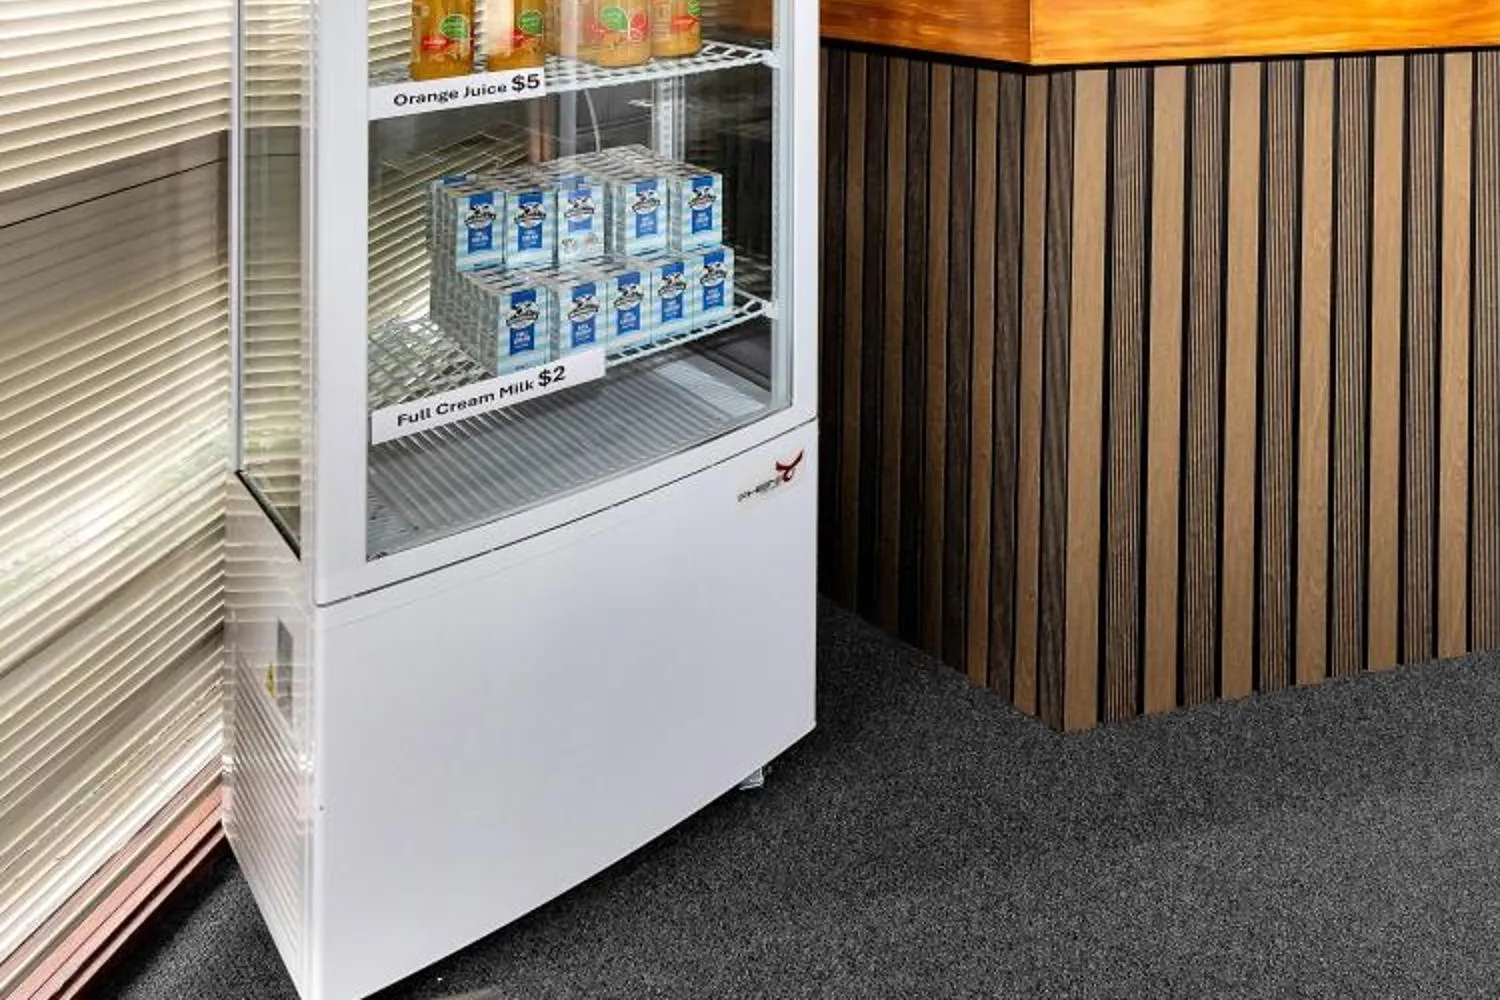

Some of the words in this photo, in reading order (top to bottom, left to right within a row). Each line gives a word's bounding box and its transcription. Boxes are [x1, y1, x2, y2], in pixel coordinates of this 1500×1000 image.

[393, 88, 459, 107] Orange
[463, 81, 508, 99] Juice
[511, 72, 541, 93] $5
[397, 409, 432, 427] Full
[436, 393, 496, 416] Cream
[500, 380, 534, 398] Milk
[538, 365, 567, 388] $2
